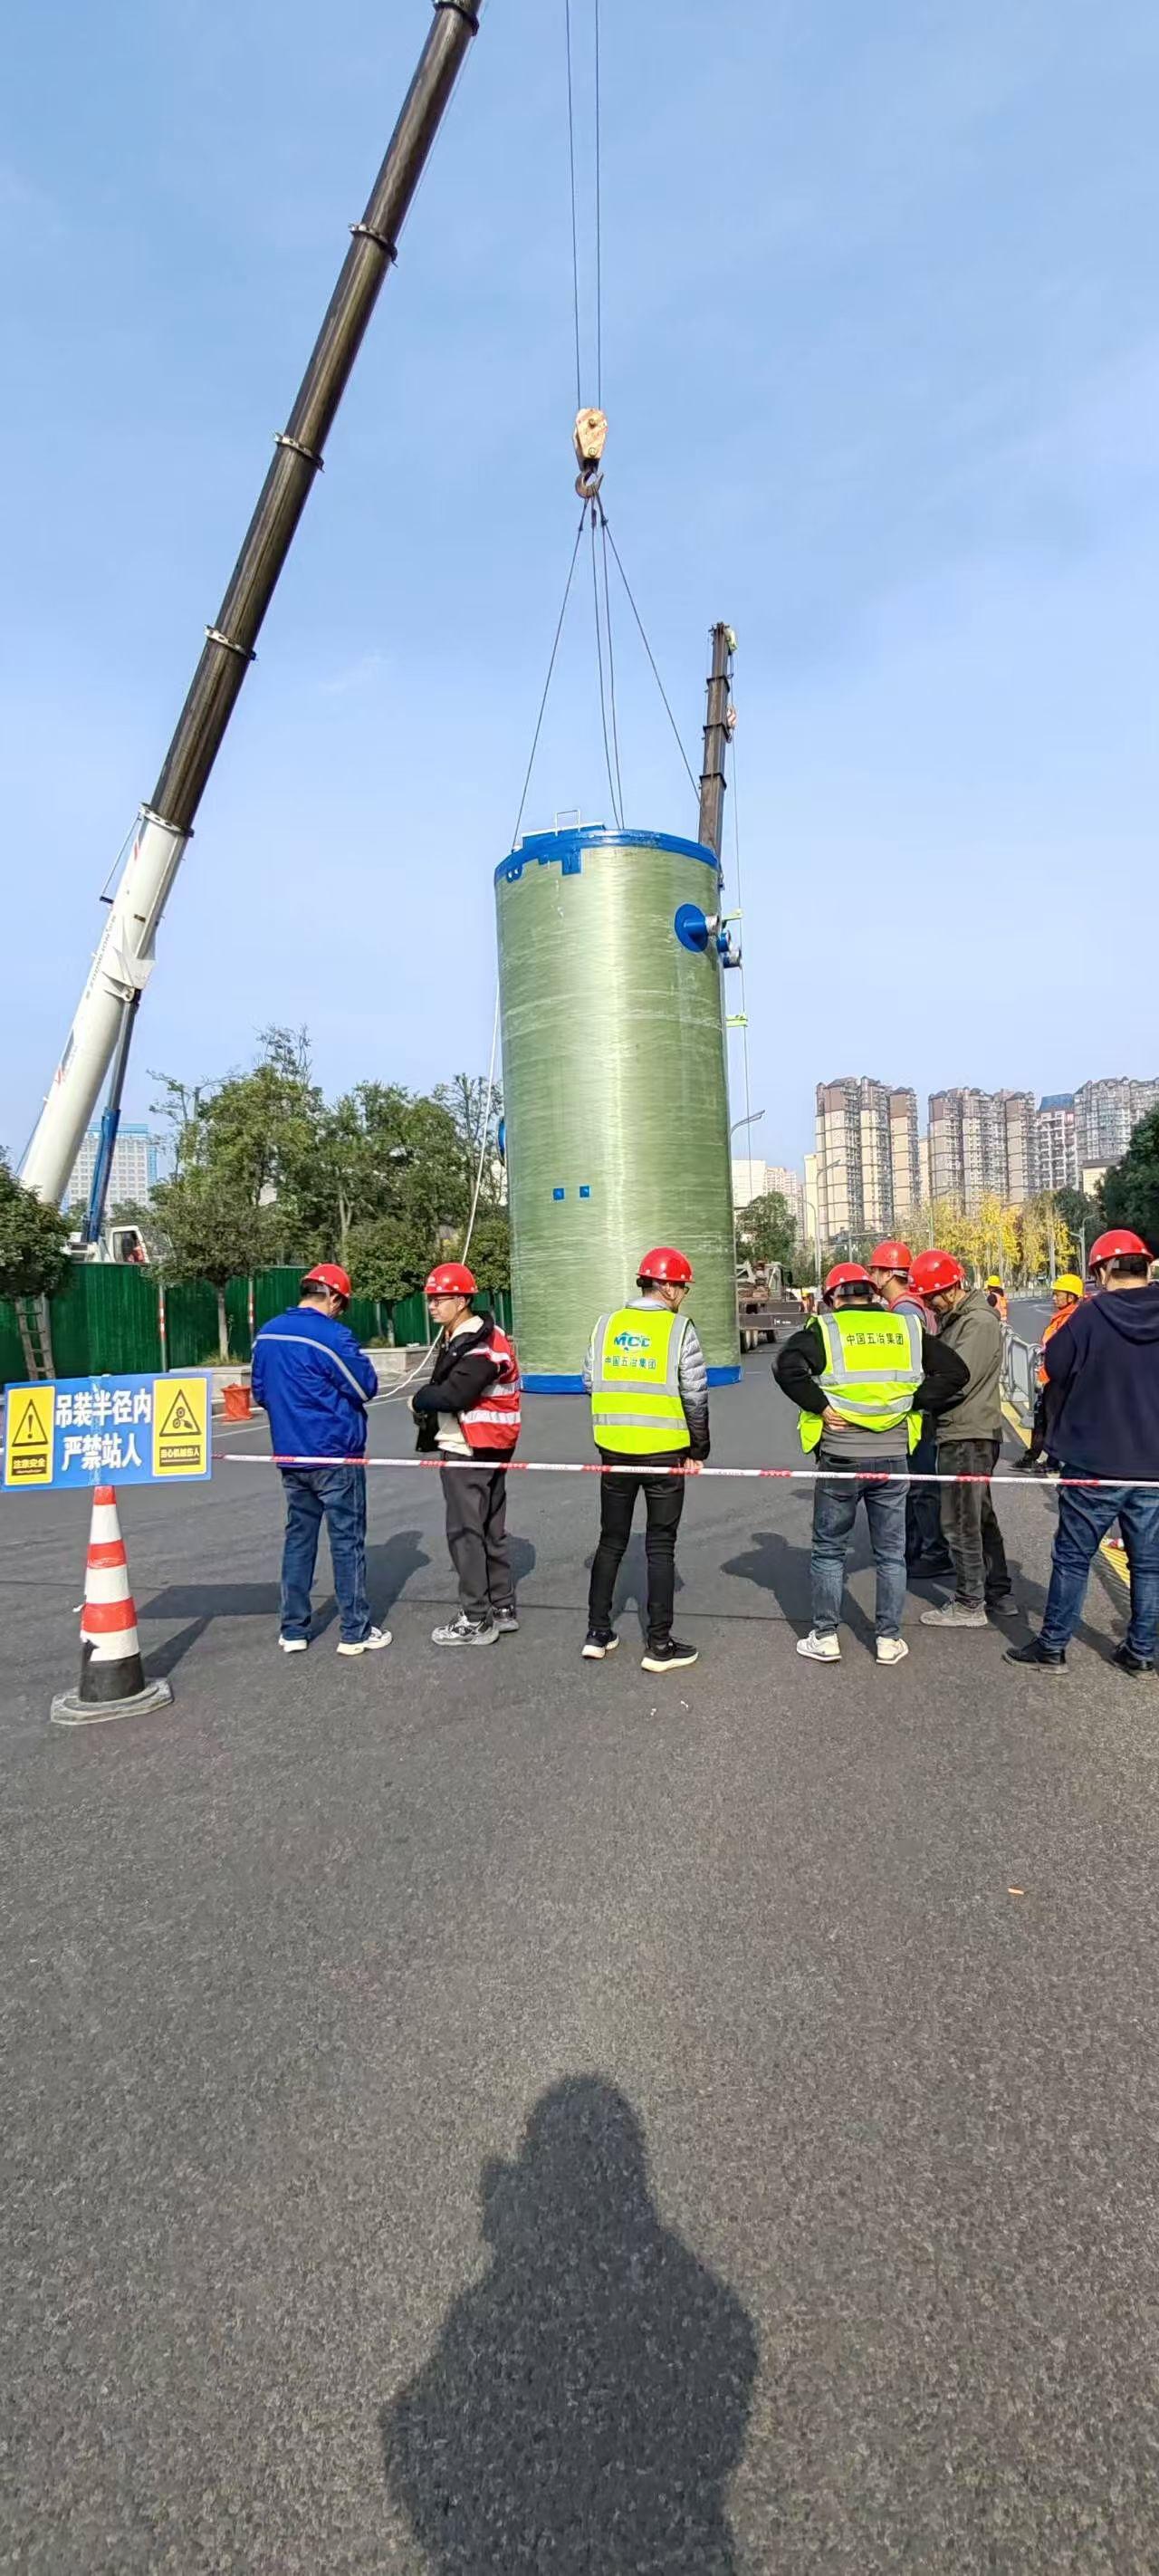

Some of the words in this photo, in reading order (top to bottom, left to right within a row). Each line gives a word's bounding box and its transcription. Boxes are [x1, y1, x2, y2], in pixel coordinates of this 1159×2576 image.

[614, 1335, 650, 1348] MCC
[847, 1332, 904, 1346] 中国五冶集团
[605, 1355, 656, 1370] 中国五冶集团
[55, 1388, 152, 1428] 吊装半径内
[61, 1432, 142, 1471] 严禁站人
